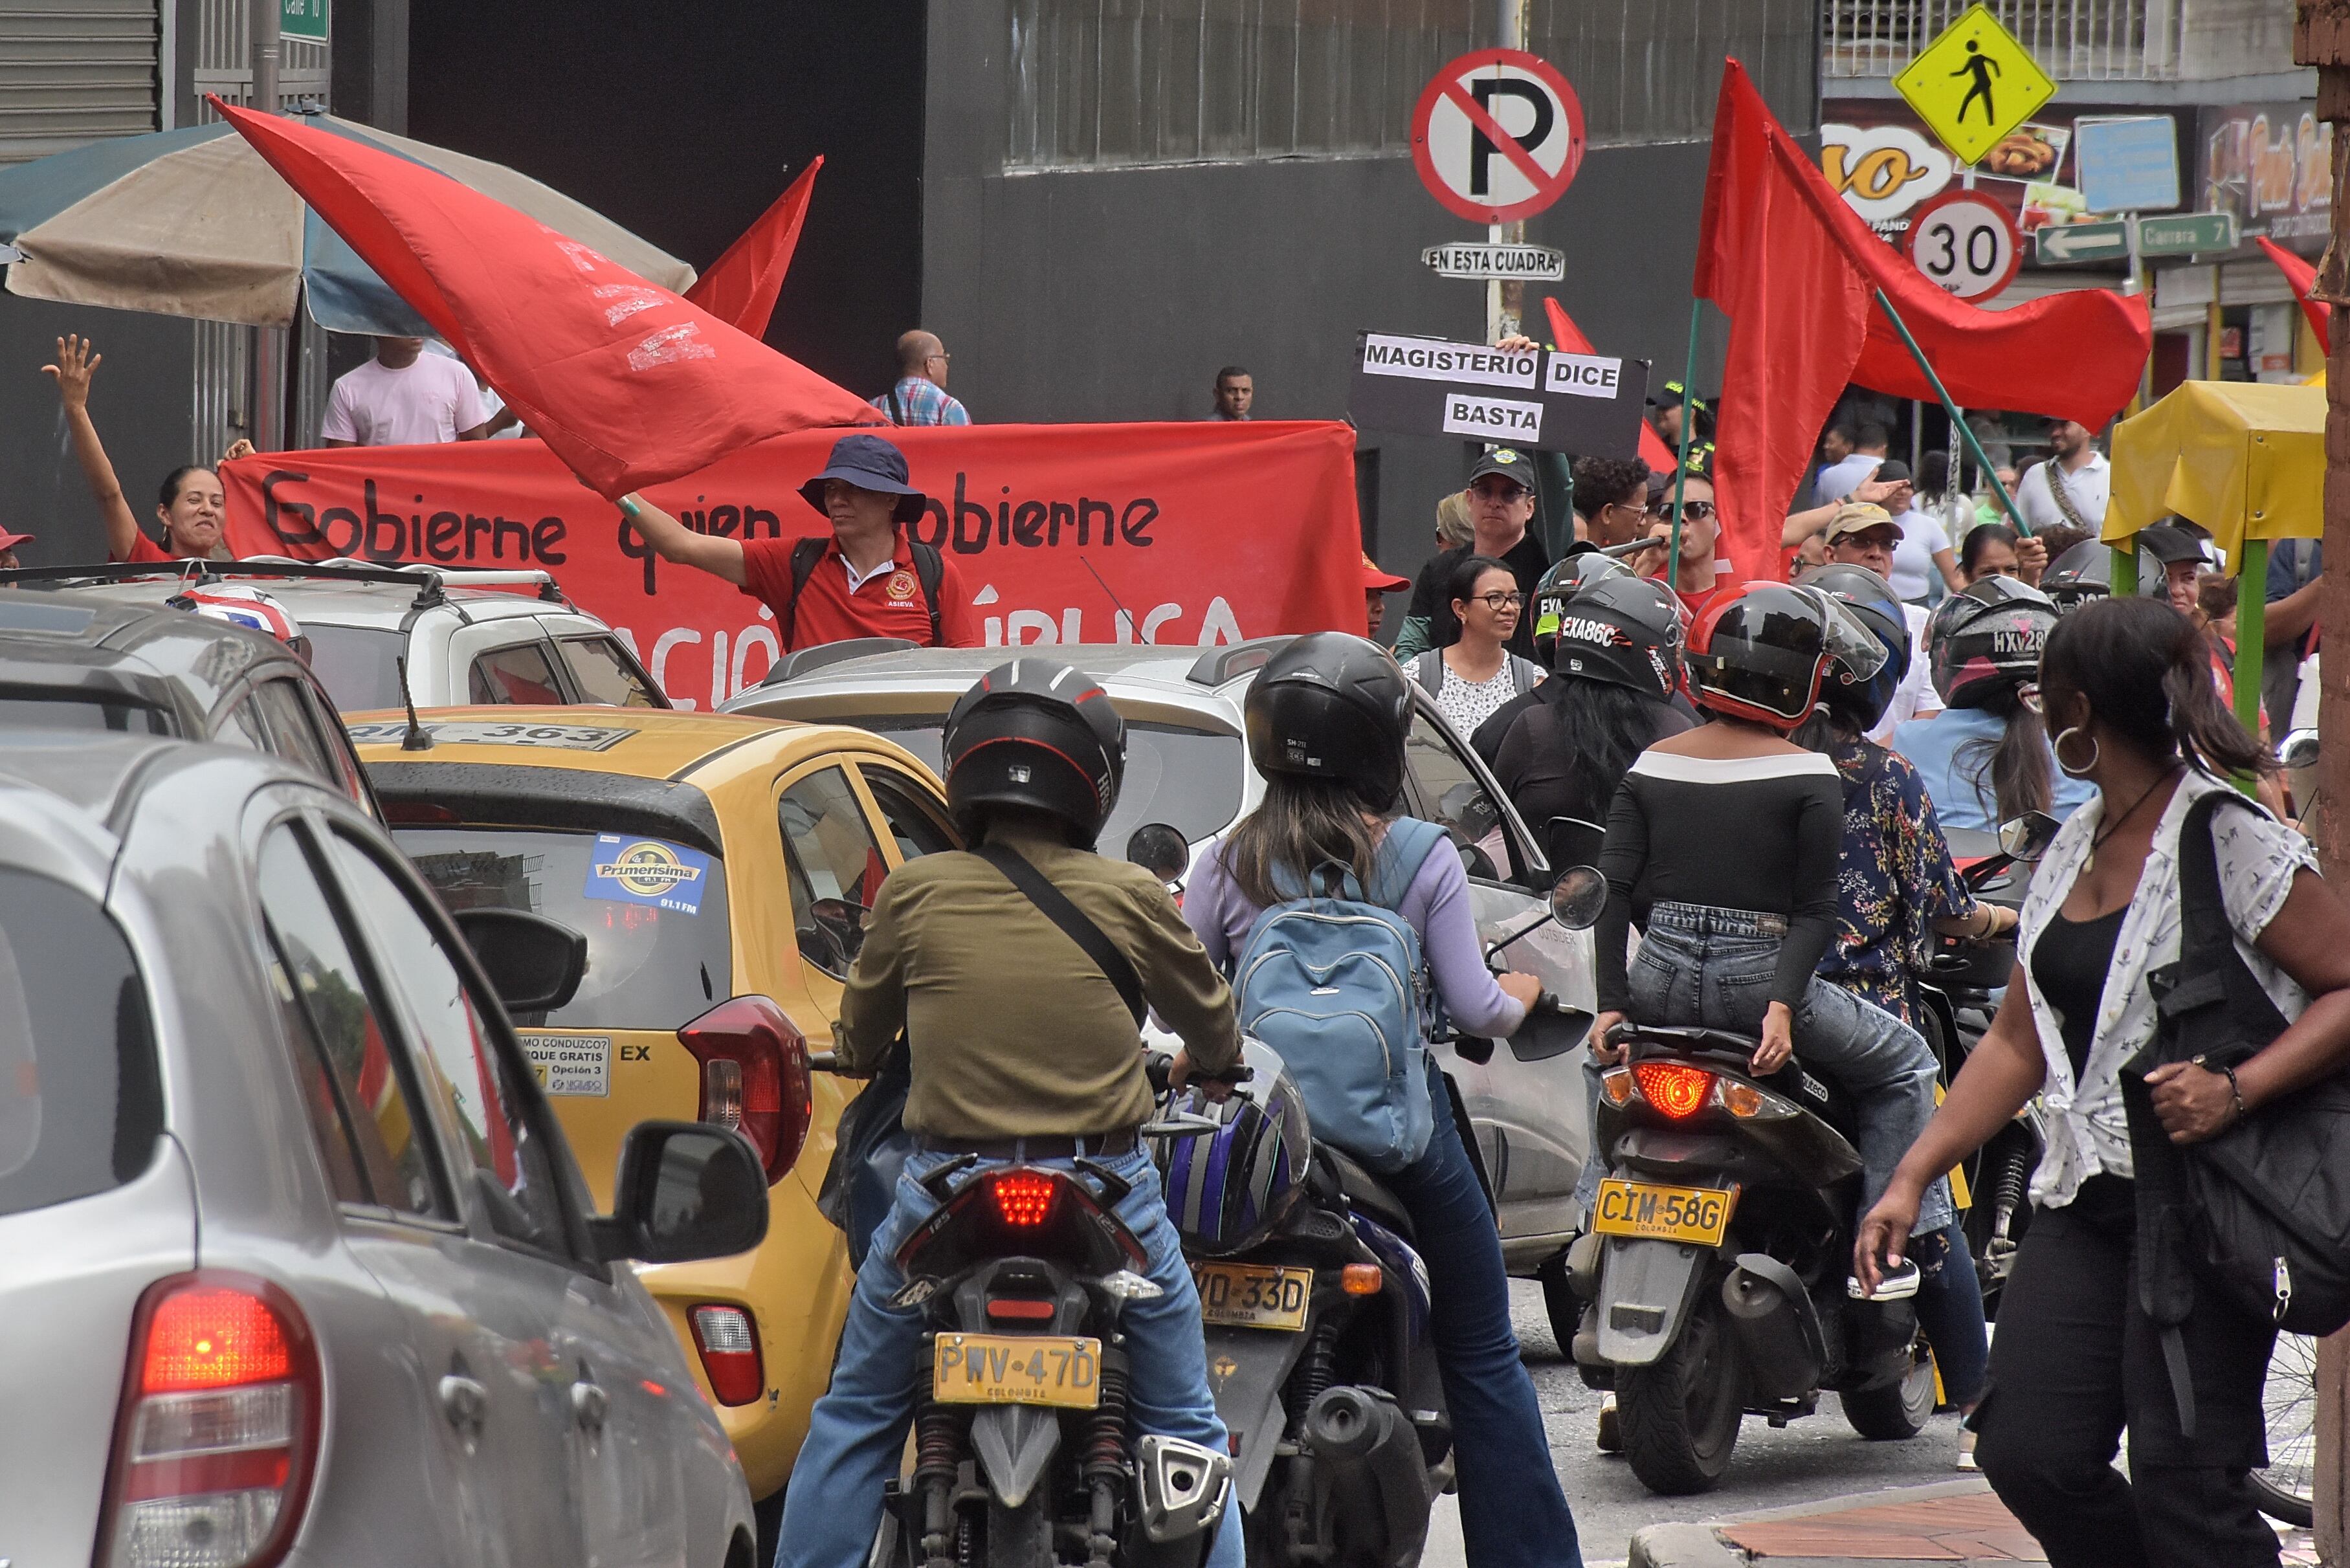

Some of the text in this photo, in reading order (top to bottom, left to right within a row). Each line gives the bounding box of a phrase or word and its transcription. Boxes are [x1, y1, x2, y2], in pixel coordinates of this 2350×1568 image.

[2145, 228, 2197, 245] Carrera
[2214, 223, 2224, 241] 7
[1927, 223, 1997, 277] 30
[1429, 251, 1557, 272] EN ESTA CUADRA
[1366, 344, 1617, 388] MAGISTERIO DICE
[1452, 403, 1538, 430] BASTA
[262, 469, 1160, 595] Gobierne qien obierne
[1562, 617, 1615, 647] EXA86C
[1994, 630, 2050, 653] HXV28
[482, 725, 610, 742] 363
[660, 898, 697, 914] 91.1 FM
[542, 1039, 607, 1050] CONDUZCO?
[620, 1045, 650, 1061] EX
[526, 1051, 603, 1061] QUE GRATIS
[552, 1065, 591, 1075] Opción
[1635, 1223, 1678, 1234] COLOMBIA
